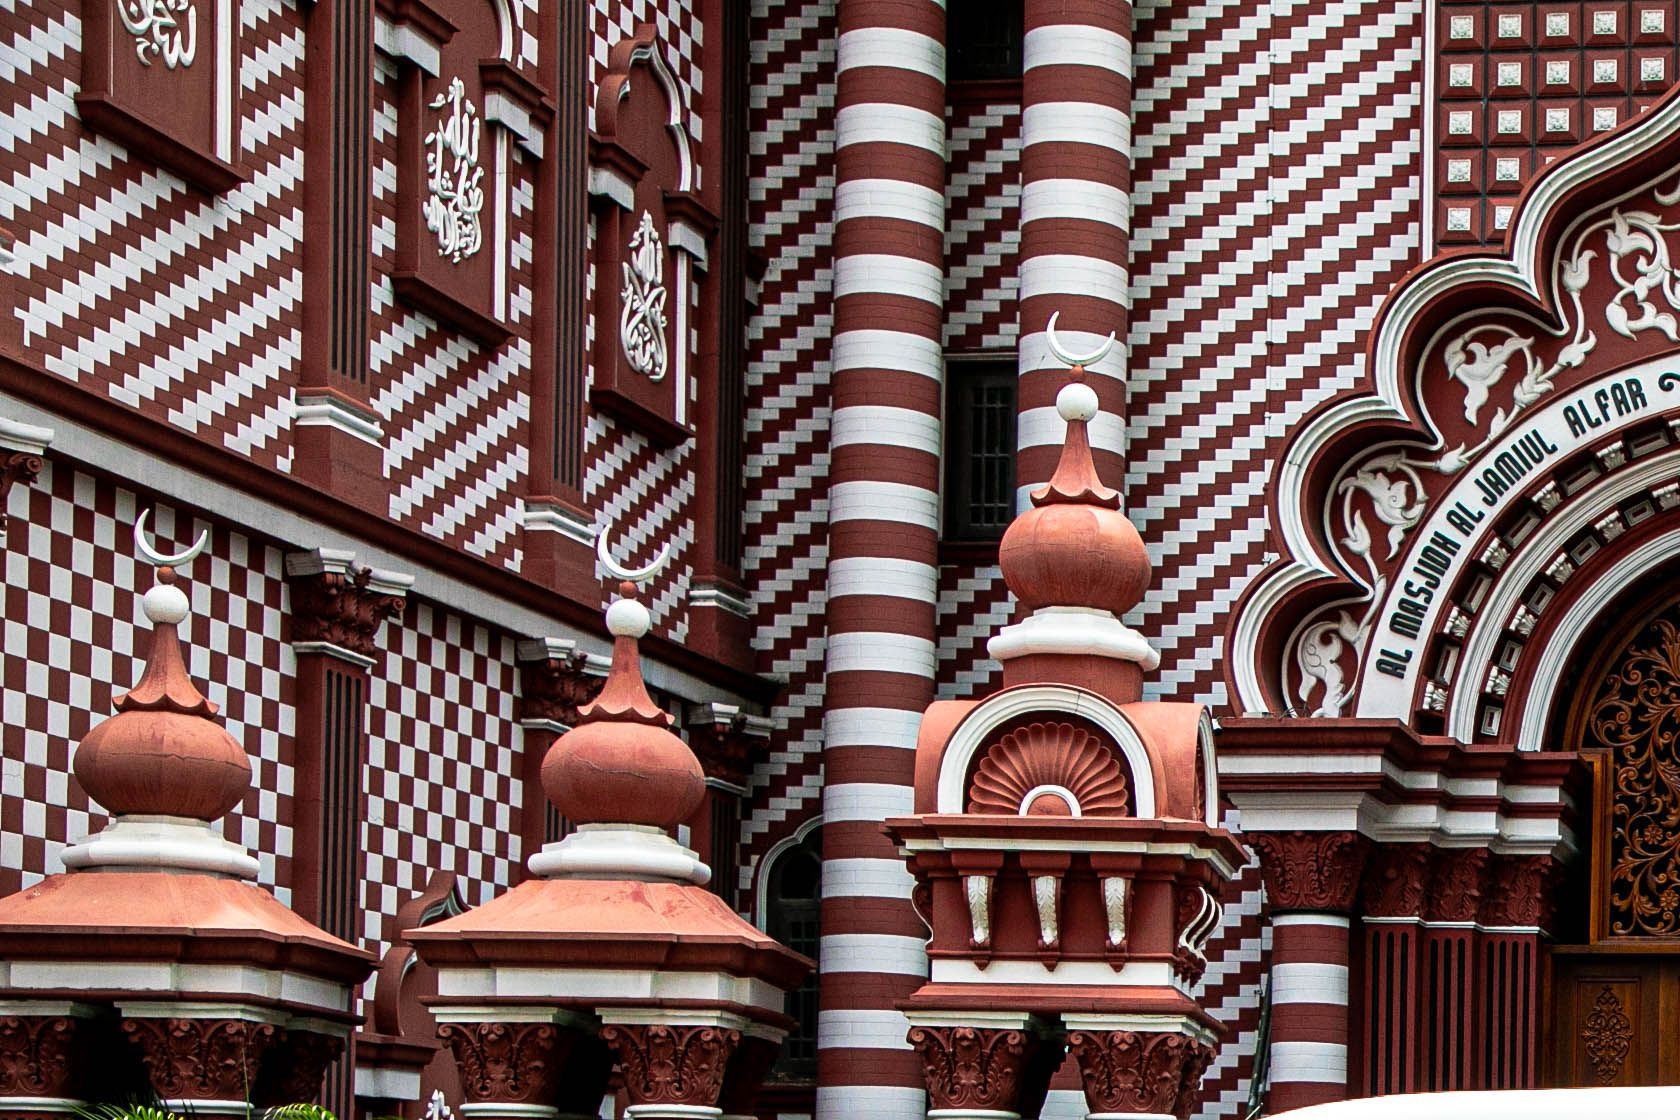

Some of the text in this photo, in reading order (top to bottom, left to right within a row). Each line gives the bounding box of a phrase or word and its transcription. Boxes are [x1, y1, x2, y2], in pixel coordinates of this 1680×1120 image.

[1376, 378, 1647, 679] AL MASJIDH AL JAMIUL ALFAR
